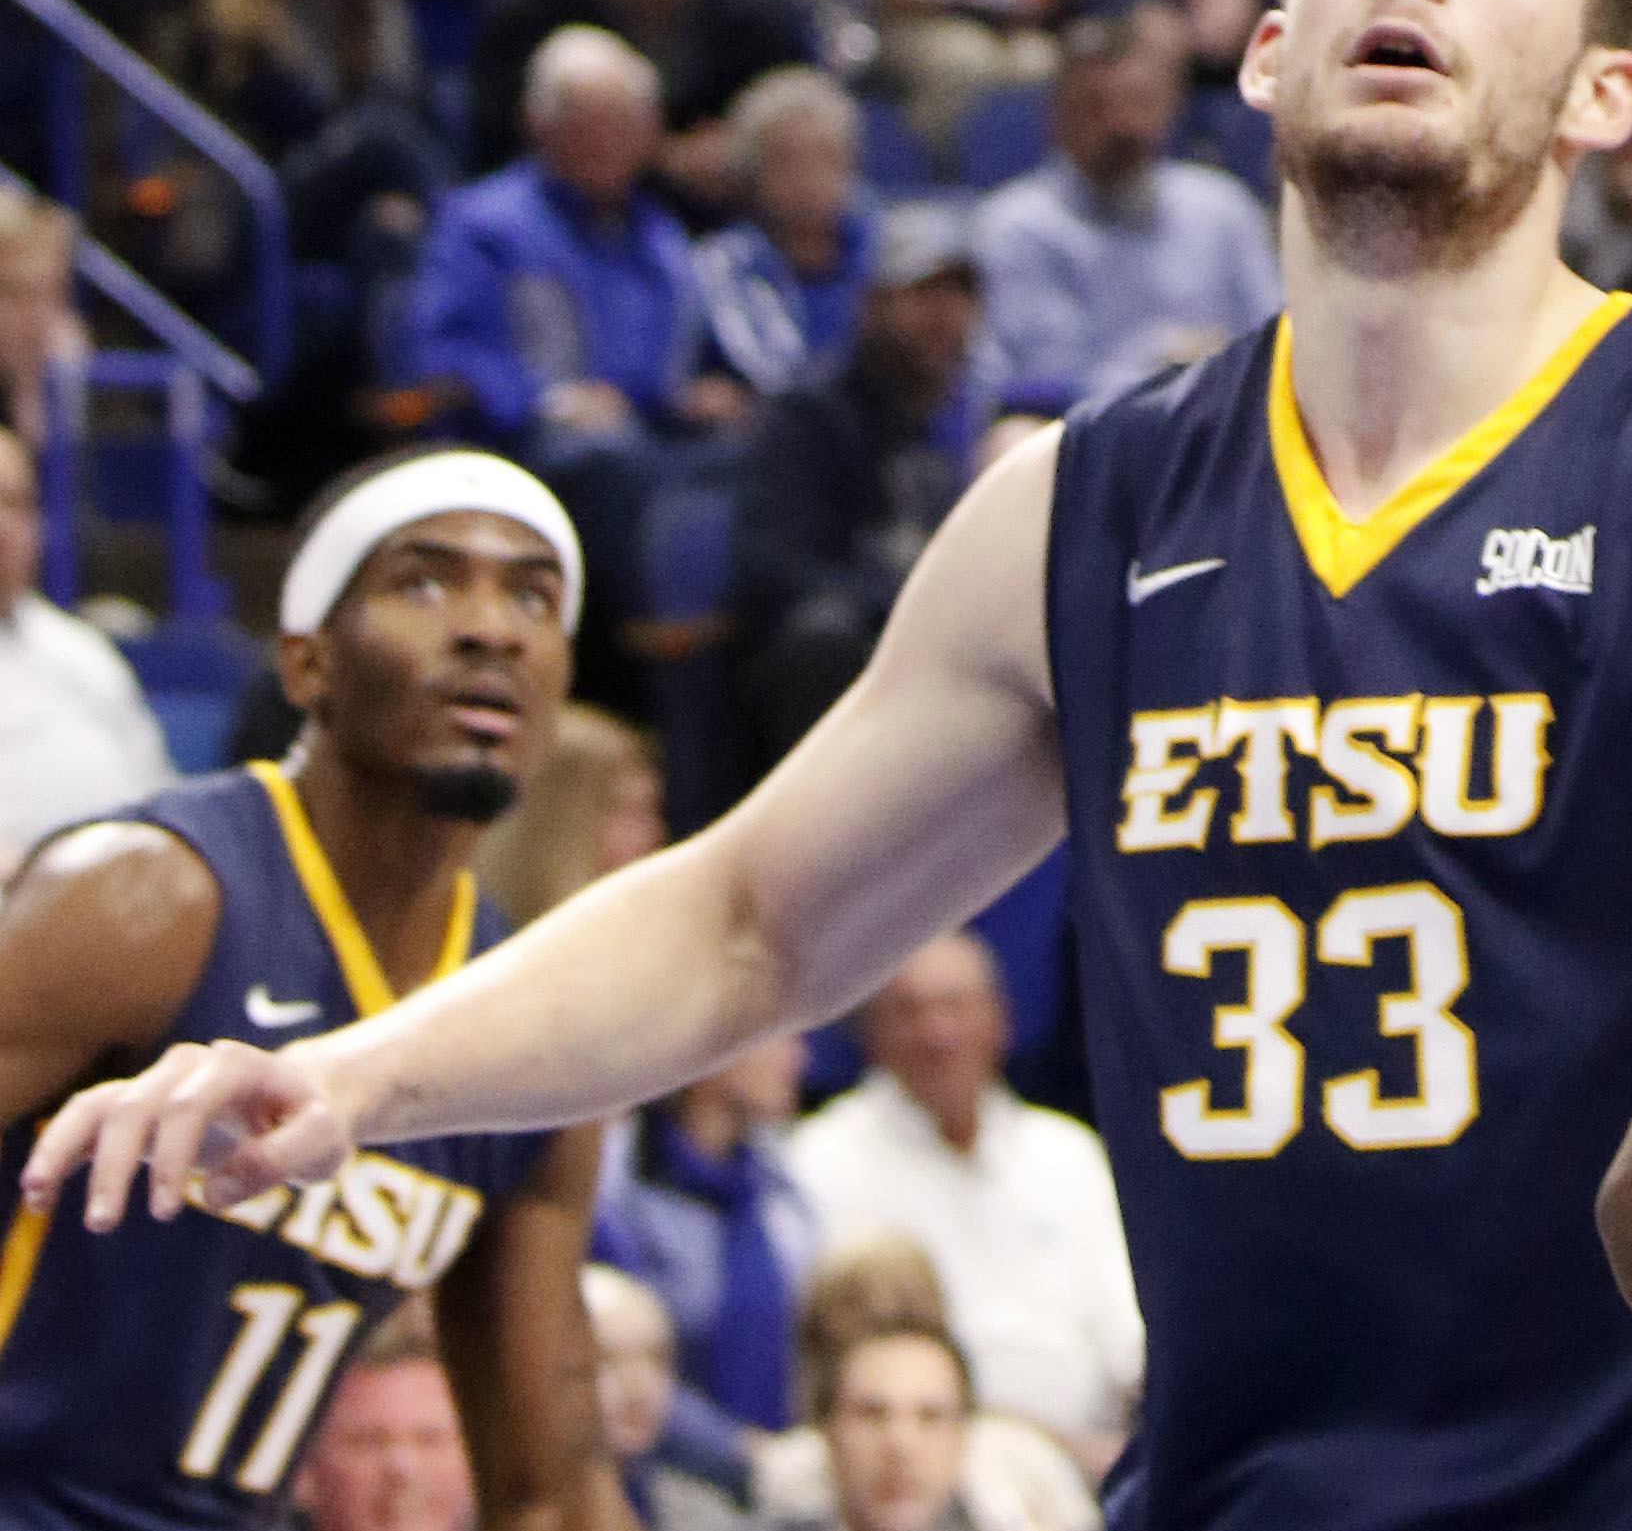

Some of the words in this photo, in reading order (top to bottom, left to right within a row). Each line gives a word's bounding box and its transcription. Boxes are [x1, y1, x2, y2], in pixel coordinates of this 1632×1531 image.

[1115, 692, 1556, 854] ETSU
[1159, 881, 1482, 1161] 33
[180, 1282, 362, 1493] 11
